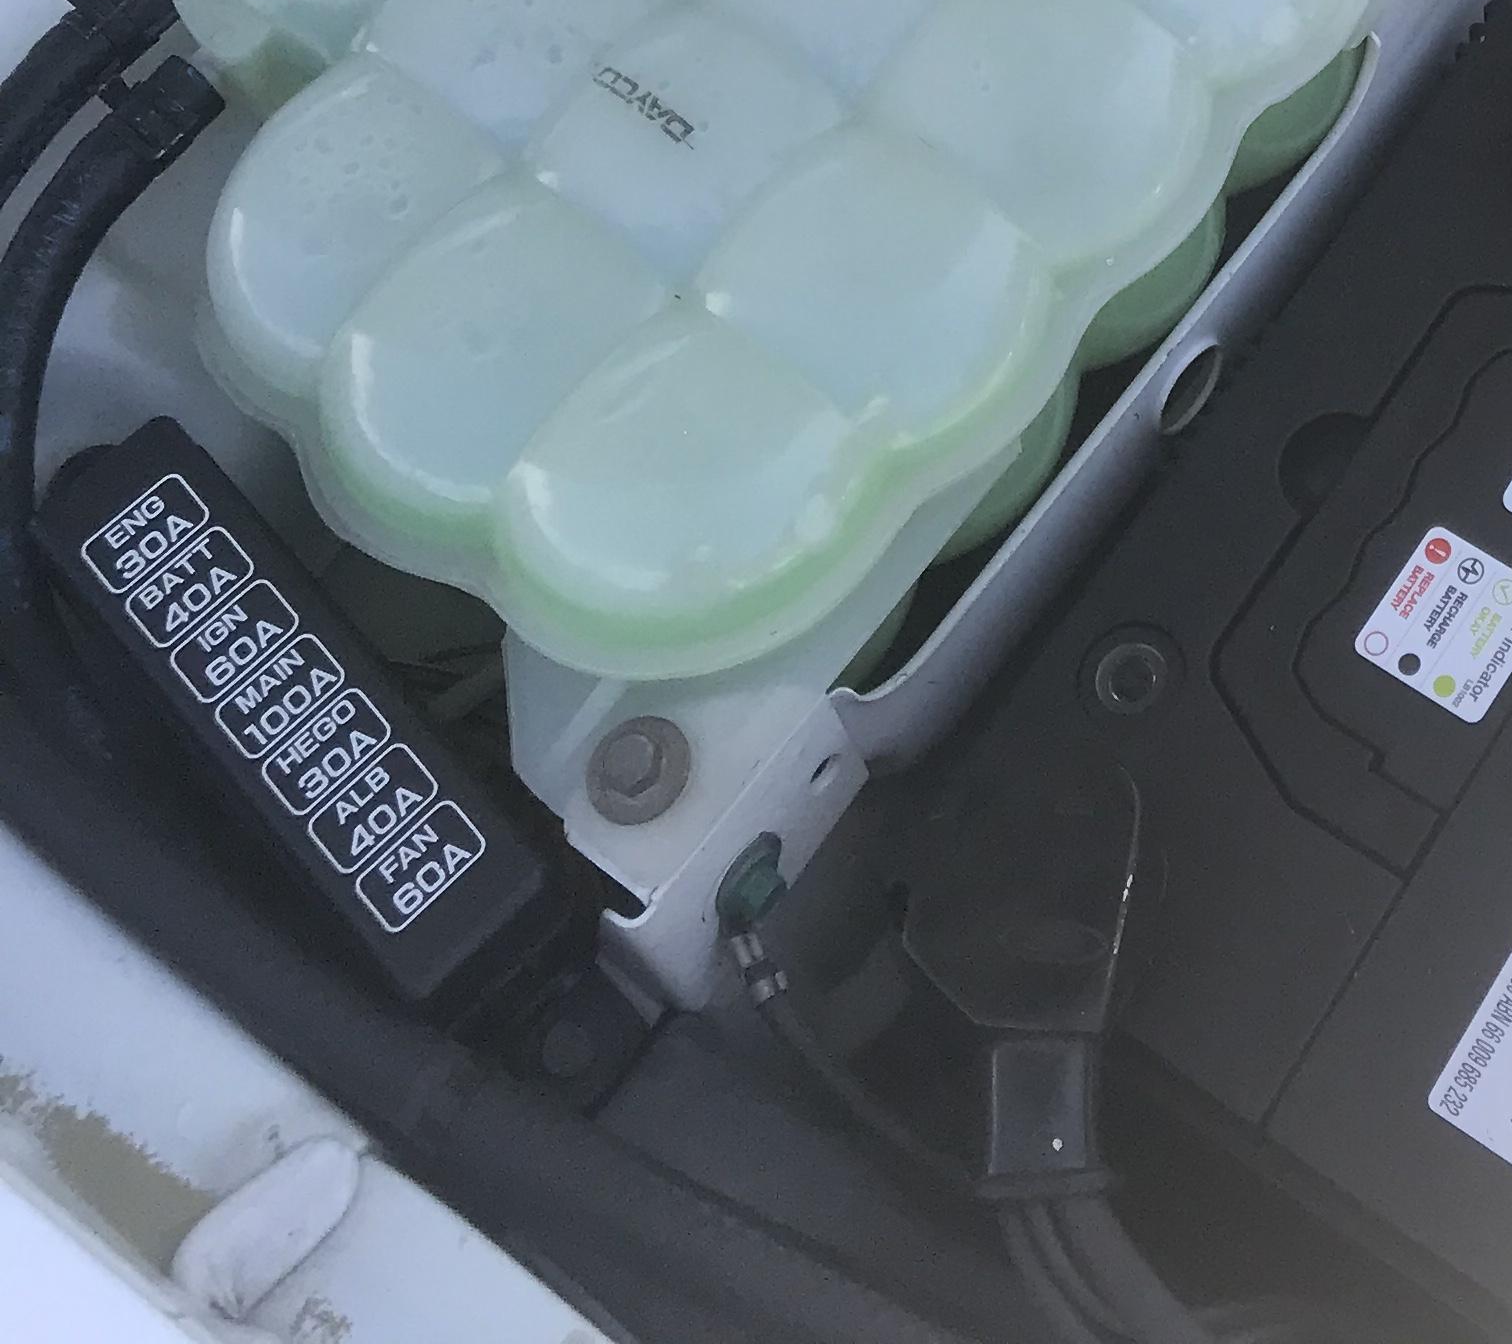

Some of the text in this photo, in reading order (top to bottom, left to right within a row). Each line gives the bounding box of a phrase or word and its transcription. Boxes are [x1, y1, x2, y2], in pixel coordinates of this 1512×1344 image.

[104, 496, 165, 549] ENG
[116, 515, 192, 581] 30A
[139, 541, 214, 611] BATT
[165, 565, 236, 633] 40A
[1391, 564, 1424, 611] BATTERY
[1398, 570, 1435, 620] REPLACE
[197, 604, 248, 652] IGN
[1424, 585, 1456, 632] BATTERY
[1426, 591, 1468, 649] RECHARGE
[1471, 606, 1491, 636] OKAY
[1472, 610, 1503, 659] BATTERY
[207, 621, 283, 687] 60A
[235, 650, 303, 713] MAIN
[244, 665, 338, 745] 100A
[277, 699, 355, 774] HEGO
[298, 729, 376, 799] 30A
[335, 765, 389, 824] ALB
[347, 786, 423, 855] 40A
[379, 824, 438, 882] FAN
[393, 843, 471, 914] 60A
[1467, 1037, 1498, 1071] 009
[1481, 1020, 1507, 1046] 66
[1440, 1085, 1470, 1119] 232
[1454, 1061, 1484, 1095] 685
